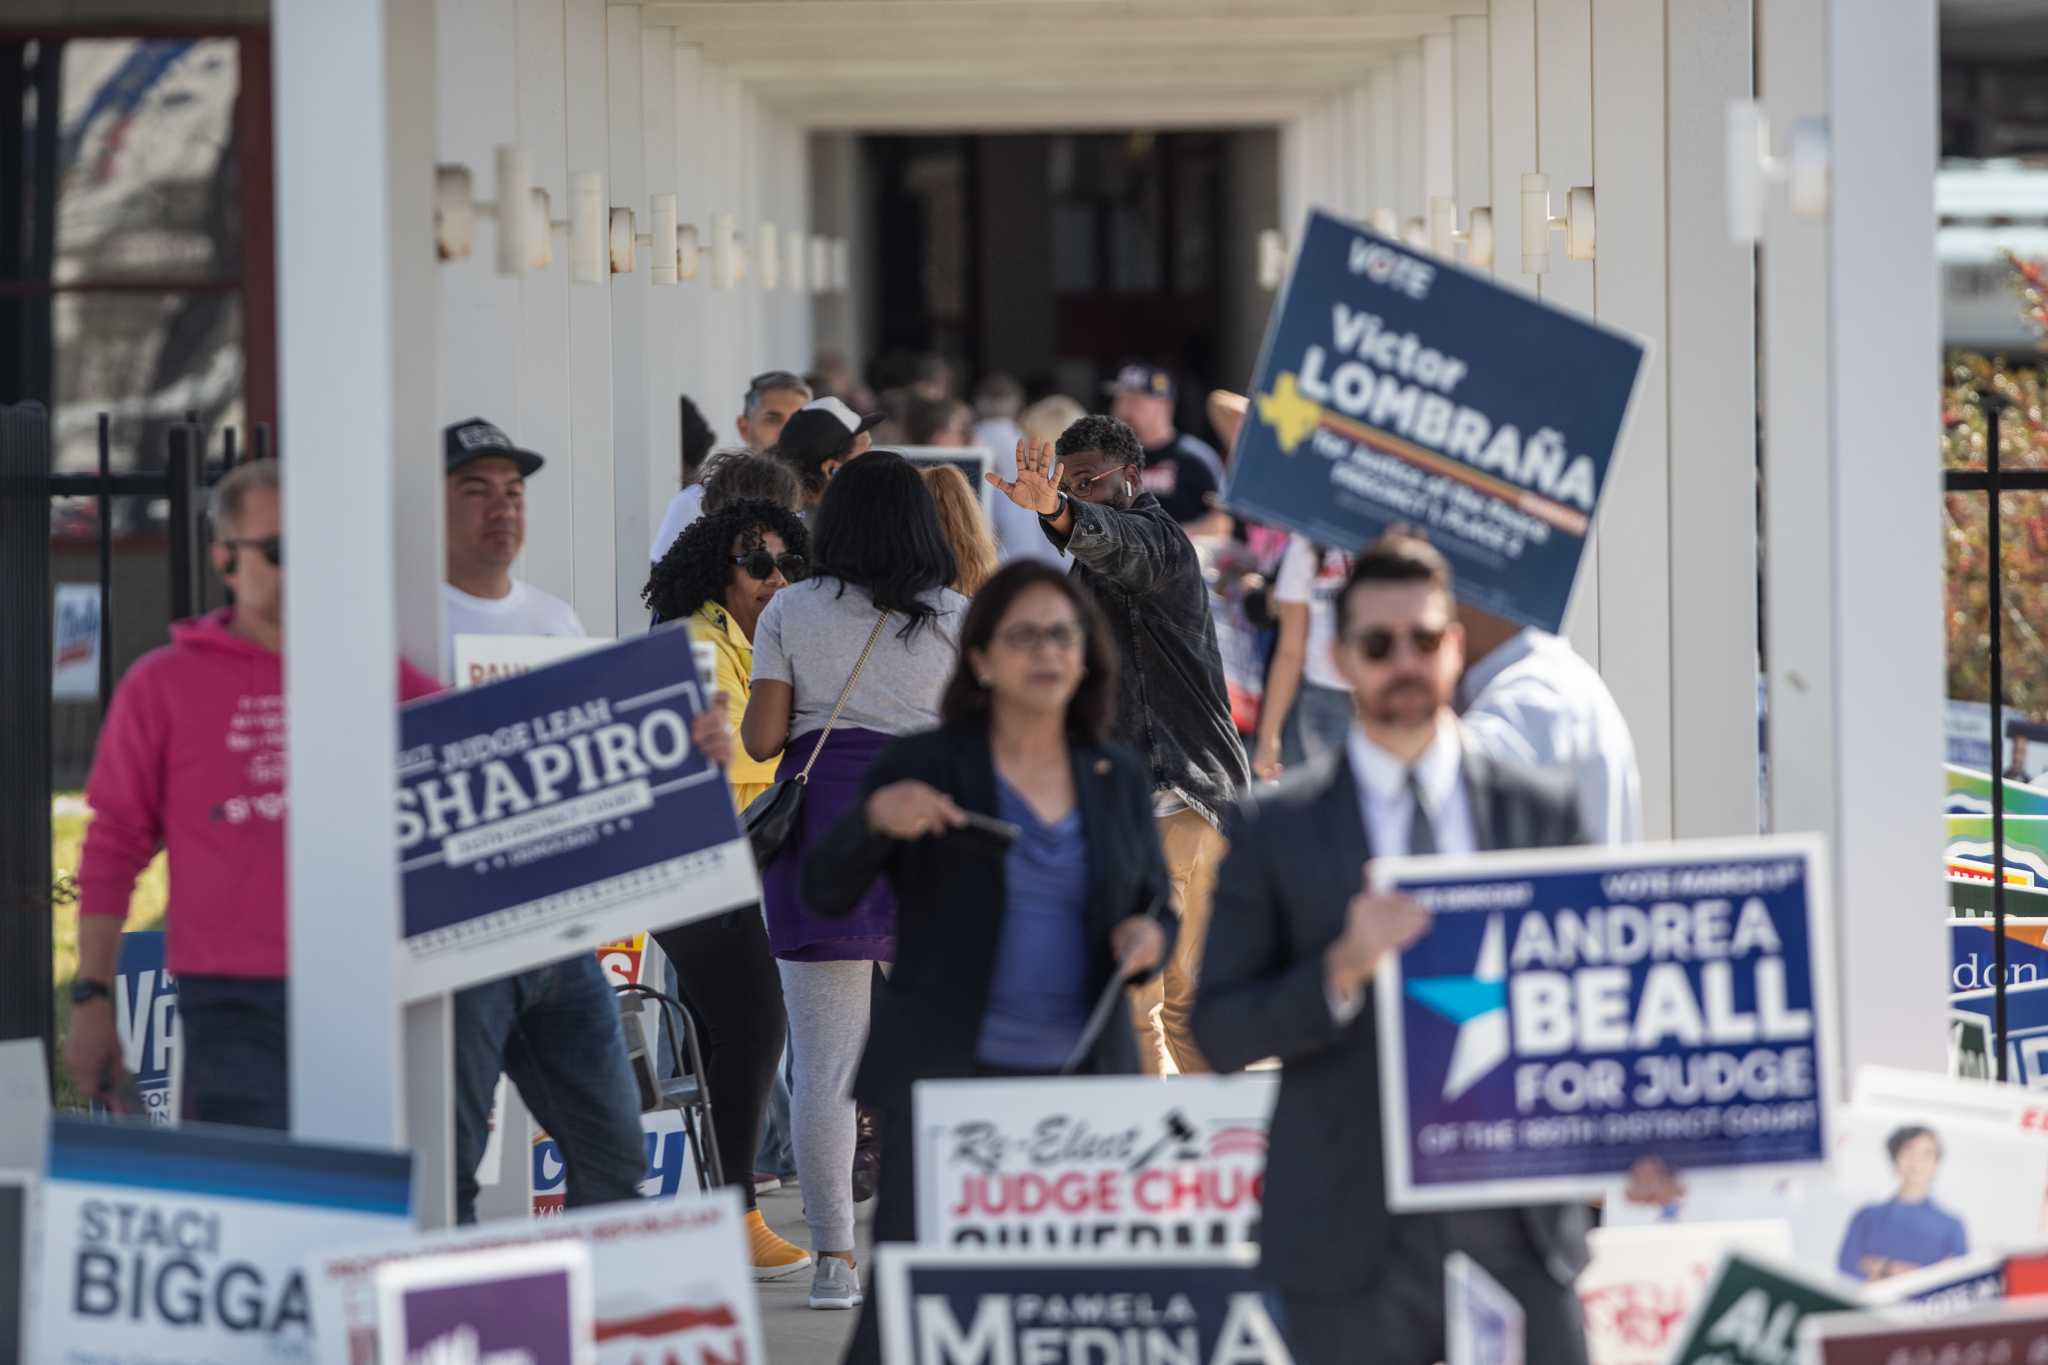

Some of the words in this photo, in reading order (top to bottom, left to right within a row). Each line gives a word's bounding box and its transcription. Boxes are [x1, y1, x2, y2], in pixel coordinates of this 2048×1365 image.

[1348, 236, 1438, 299] VOTE
[1332, 303, 1469, 391] Victor
[1298, 346, 1598, 508] LOMBRAÑA
[441, 720, 533, 773] JUDGE
[532, 698, 613, 743] LEAH
[399, 708, 690, 849] SHAPIRO
[1603, 871, 1672, 900] VOTE
[1510, 896, 1783, 970] ANDREA
[1509, 955, 1812, 1056] BEALL
[1513, 1058, 1627, 1113] FOR
[1632, 1047, 1815, 1107] JUDGE
[1418, 1122, 1458, 1156] OF
[1462, 1119, 1517, 1152] THE
[1723, 1101, 1815, 1139] COURT
[78, 1200, 221, 1254] STACI
[952, 1170, 1122, 1217] JUDGE
[914, 1293, 1300, 1365] MEDINA
[1016, 1293, 1197, 1325] PAMELA
